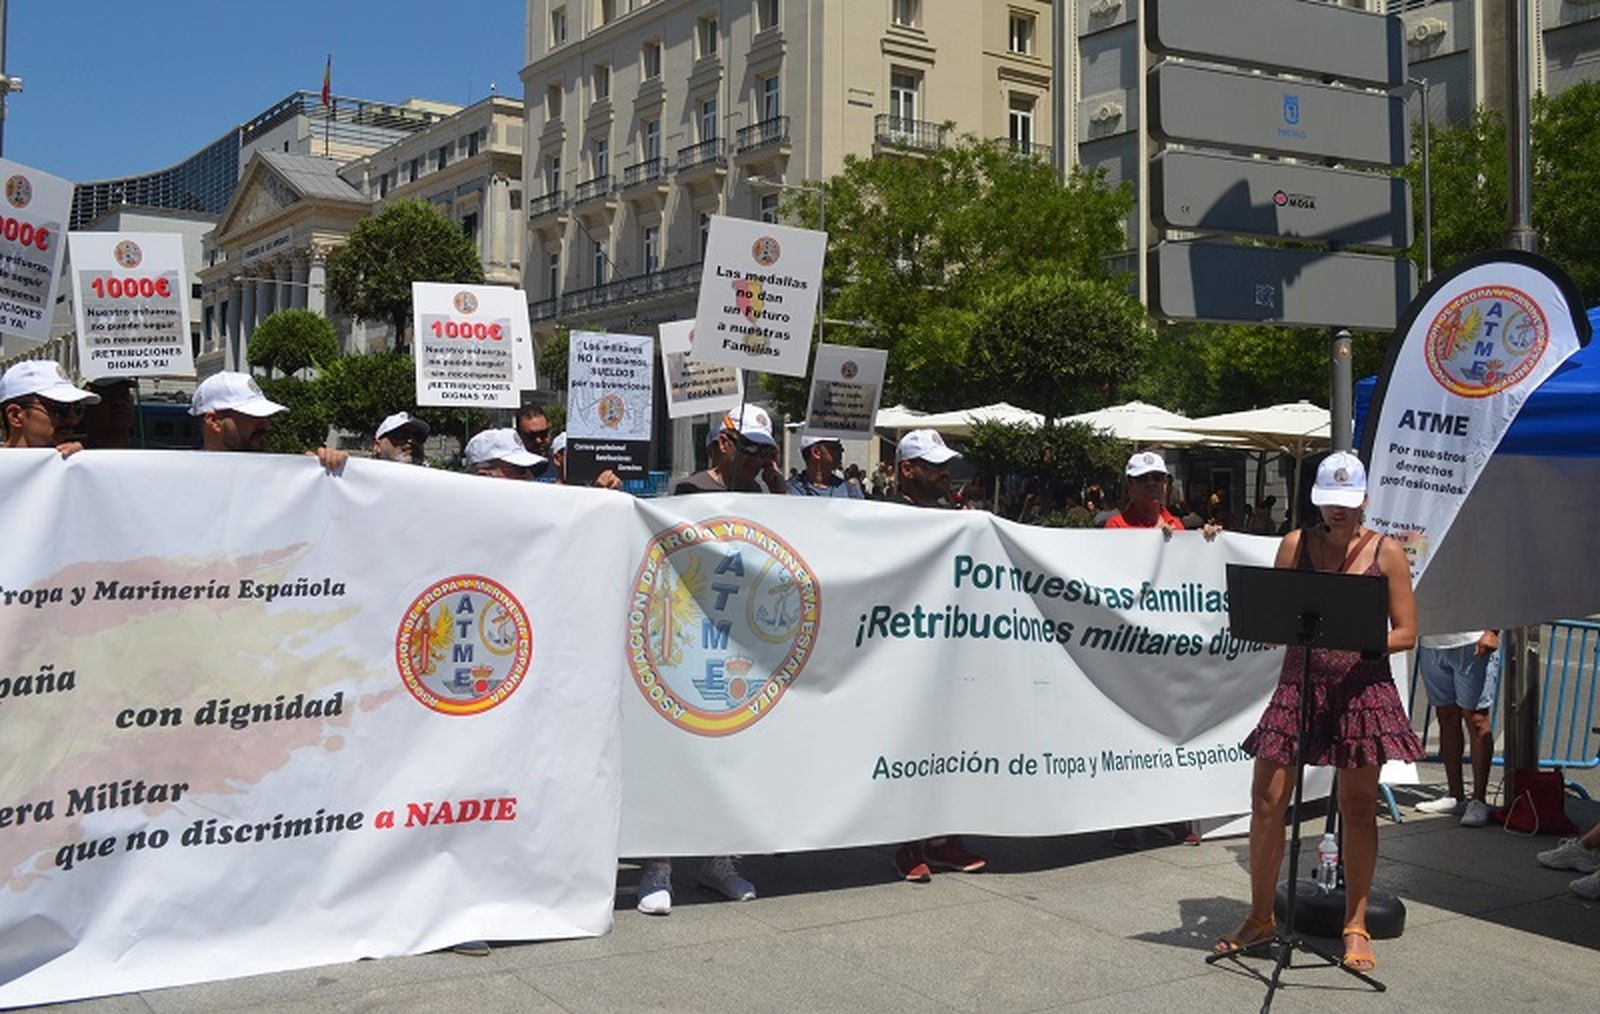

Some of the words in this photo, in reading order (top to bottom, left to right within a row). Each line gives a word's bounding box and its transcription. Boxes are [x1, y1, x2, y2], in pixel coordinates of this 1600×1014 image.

[0, 213, 51, 251] 00€
[91, 277, 171, 299] 1000€
[716, 265, 741, 279] Las
[745, 271, 808, 290] medallas
[736, 288, 753, 299] no
[757, 289, 783, 304] dan
[723, 305, 740, 315] un
[745, 306, 790, 323] Futuro
[431, 320, 503, 341] 1000€
[717, 322, 726, 332] a
[729, 323, 791, 341] nuestras
[583, 341, 600, 351] Los
[722, 339, 780, 357] Familias
[107, 360, 149, 370] DIGNAS
[577, 353, 593, 363] NO
[571, 380, 587, 389] por
[1398, 409, 1471, 437] ATME
[1388, 442, 1410, 457] Por
[1413, 447, 1467, 464] nuestros
[1395, 460, 1454, 478] derechos
[1380, 474, 1465, 496] profesionales
[70, 586, 85, 605] y
[93, 579, 231, 601] Marinería
[237, 577, 346, 602] Española
[954, 555, 1005, 591] Por
[1008, 564, 1133, 611] nuestras
[855, 605, 1074, 648] ¡Retribuciones
[1080, 622, 1203, 657] militares
[116, 705, 182, 729] con
[194, 691, 344, 730] dignidad
[873, 750, 1000, 780] Asociación
[1008, 753, 1038, 777] de
[1042, 752, 1087, 779] Tropa
[1088, 758, 1098, 778] y
[1101, 747, 1173, 772] Marinería
[65, 779, 189, 817] Militar
[55, 836, 116, 871] que
[125, 828, 169, 851] no
[181, 807, 364, 848] discrimine
[374, 810, 395, 830] a
[404, 797, 518, 828] NADIE
